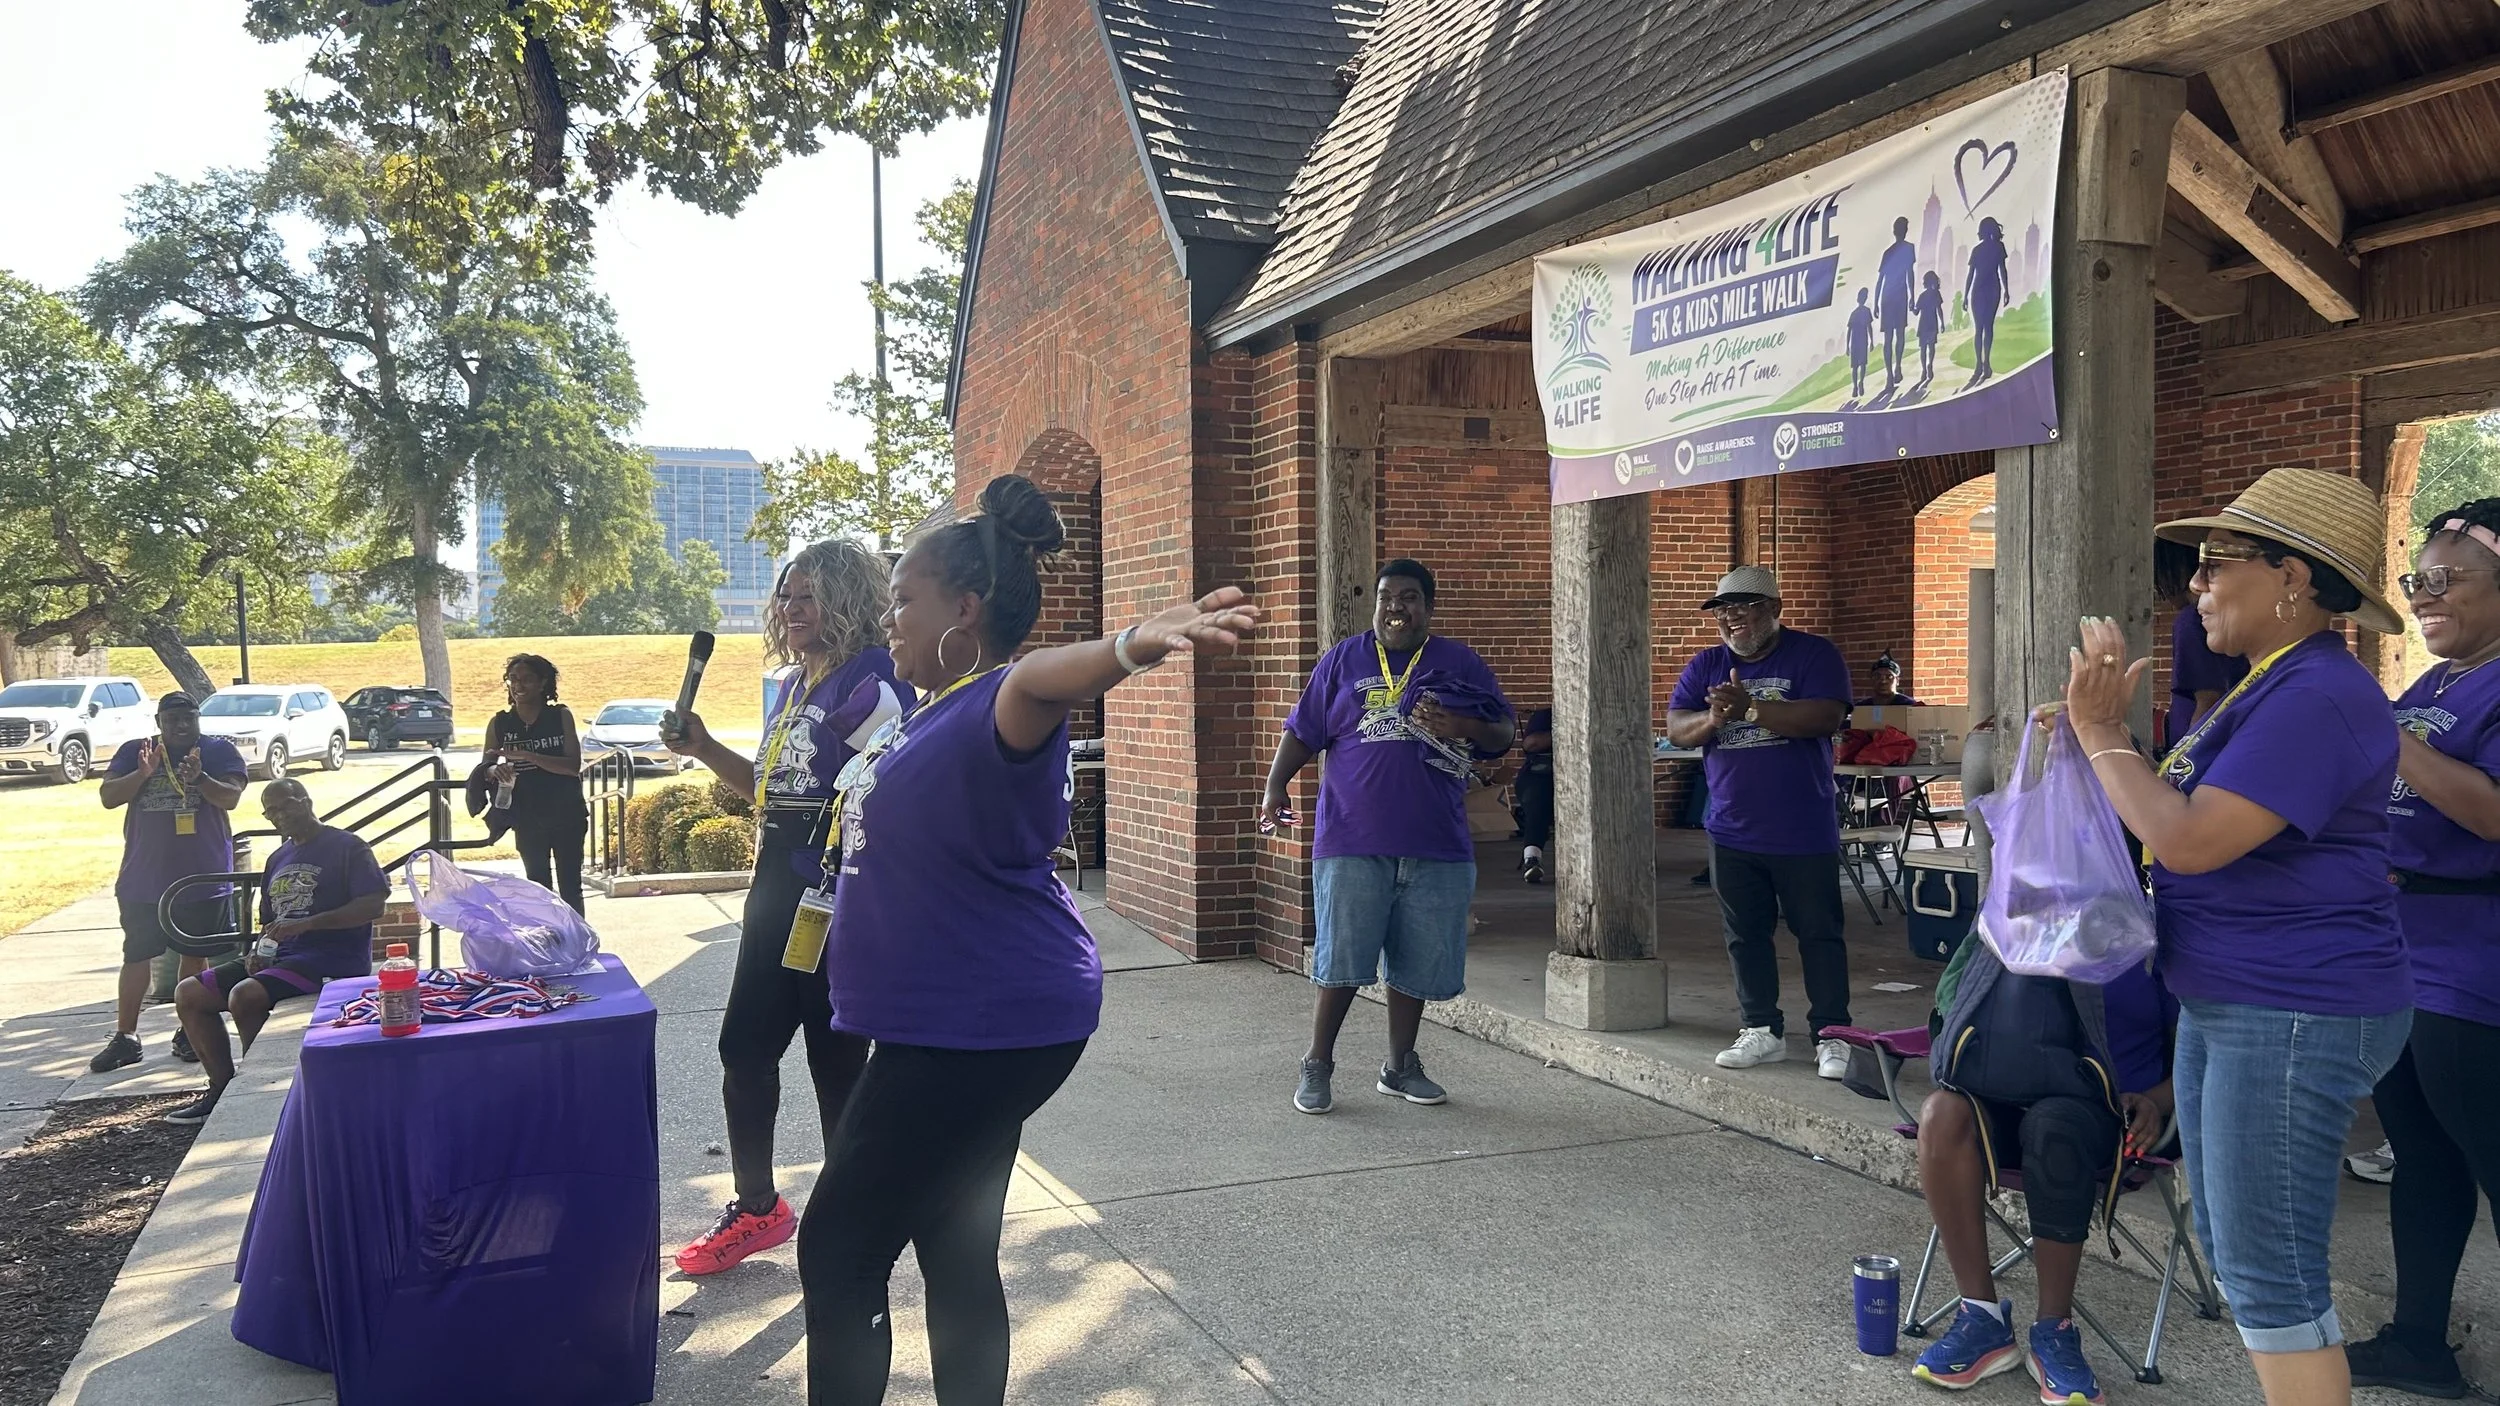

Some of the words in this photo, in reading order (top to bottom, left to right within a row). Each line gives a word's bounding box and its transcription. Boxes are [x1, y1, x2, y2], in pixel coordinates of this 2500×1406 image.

[1632, 218, 1767, 305] WALKING
[1755, 184, 1854, 266] 4LIFE
[1651, 306, 1668, 343] 5K
[1671, 305, 1682, 337] &
[1685, 293, 1719, 334] KIDS
[1721, 282, 1758, 325] MILE
[1762, 269, 1809, 314] WALK
[1646, 354, 1693, 381] Making
[1695, 342, 1710, 369] A
[1712, 331, 1787, 365] Difference
[1552, 375, 1602, 402] WALKING
[1644, 387, 1668, 412] One
[1669, 379, 1698, 404] Step
[1700, 371, 1724, 397] At
[1721, 365, 1736, 391] A
[1554, 395, 1601, 430] 4LIFE
[1696, 441, 1714, 454] RAISE
[1714, 436, 1756, 452] AWARENESS.
[1801, 421, 1844, 438] STRONGER
[1801, 435, 1846, 451] TOGETHER.
[1633, 453, 1650, 465] WALK.
[1696, 453, 1714, 466] BUILD
[1714, 451, 1733, 463] HOPE.
[713, 1208, 784, 1263] HYROX
